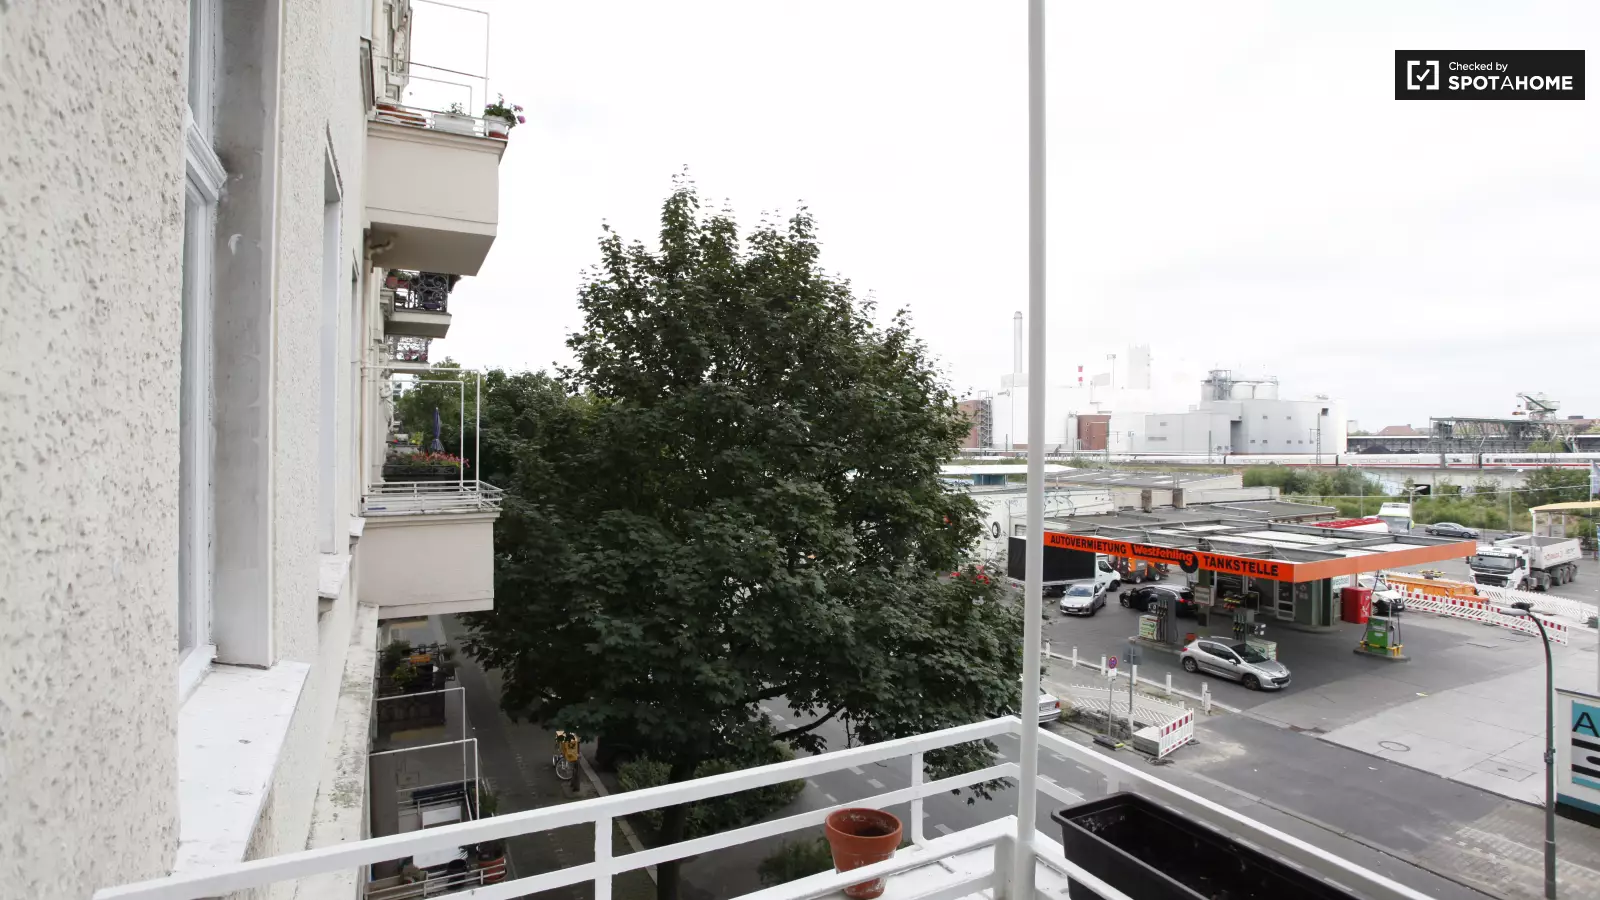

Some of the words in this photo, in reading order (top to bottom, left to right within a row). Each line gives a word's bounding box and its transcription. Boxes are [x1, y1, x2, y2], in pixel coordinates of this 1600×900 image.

[1050, 534, 1127, 555] AUTOVERMIETUNG
[1133, 544, 1193, 567] Westfehling
[1203, 555, 1279, 577] TANKSTELLE
